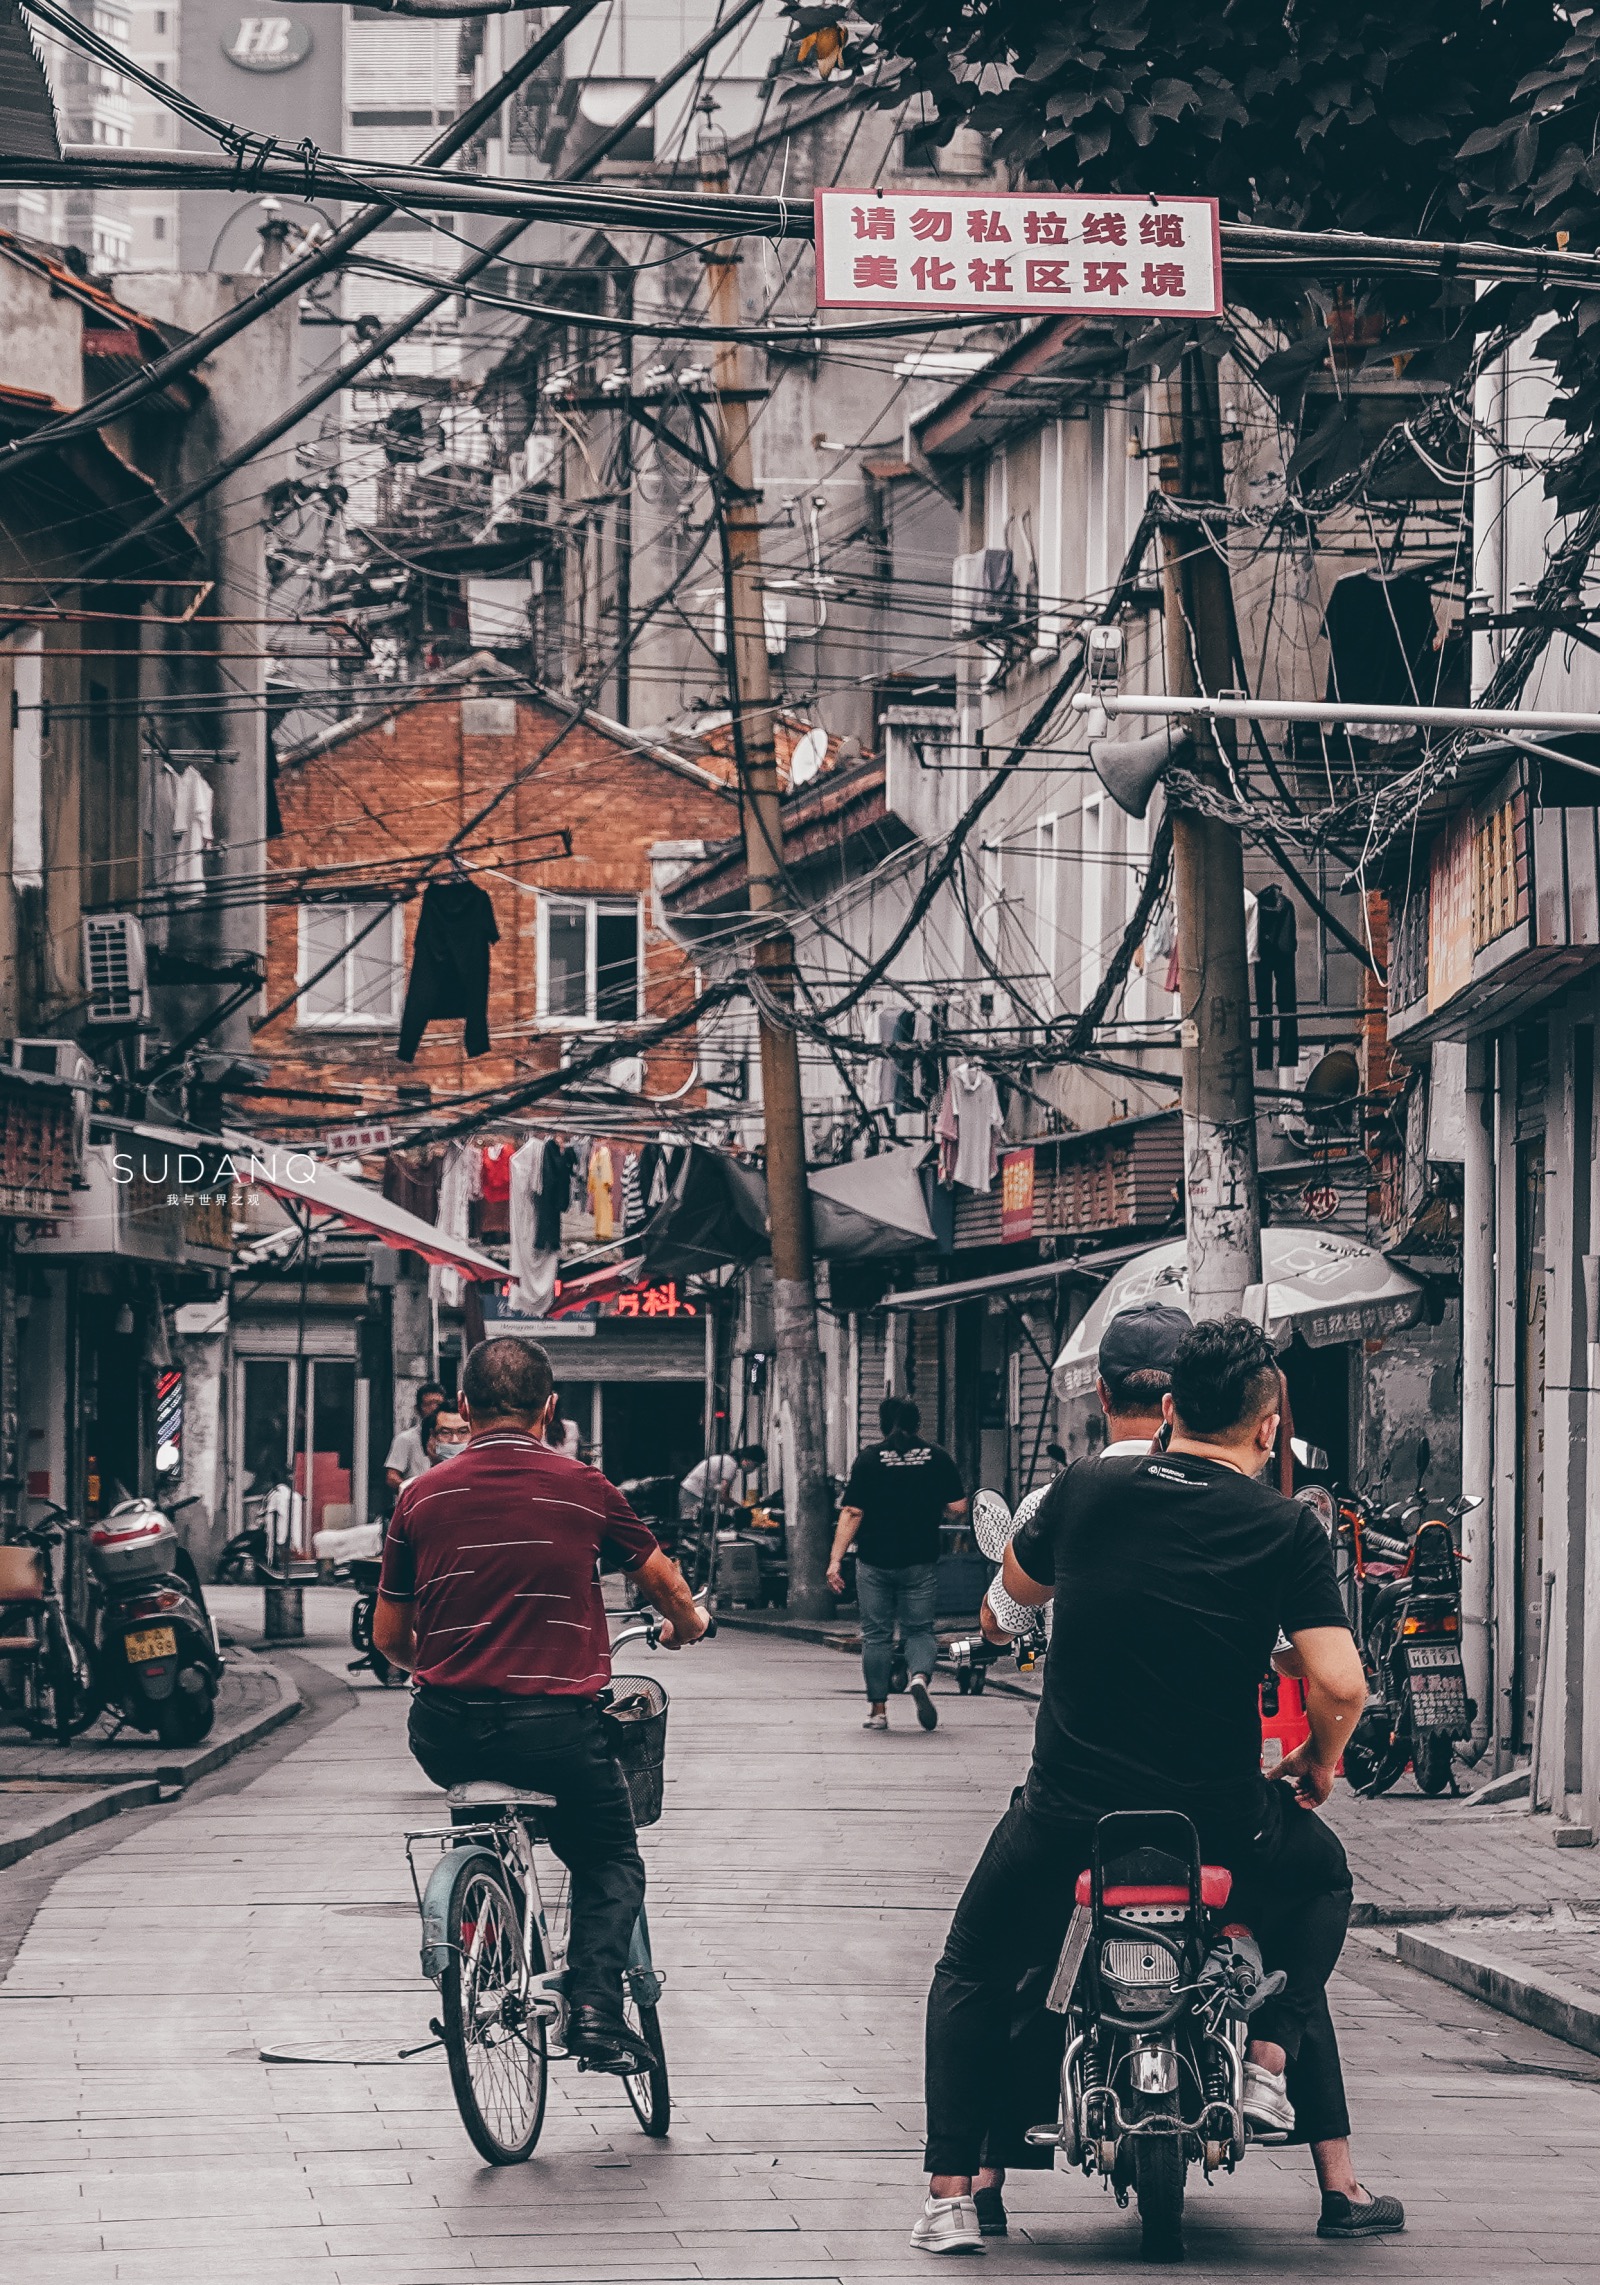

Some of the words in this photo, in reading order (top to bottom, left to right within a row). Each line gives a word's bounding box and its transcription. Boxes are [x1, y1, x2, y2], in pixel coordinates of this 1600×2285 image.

[850, 206, 1186, 248] 请勿私拉线缆
[852, 254, 1187, 298] 美化社区环境
